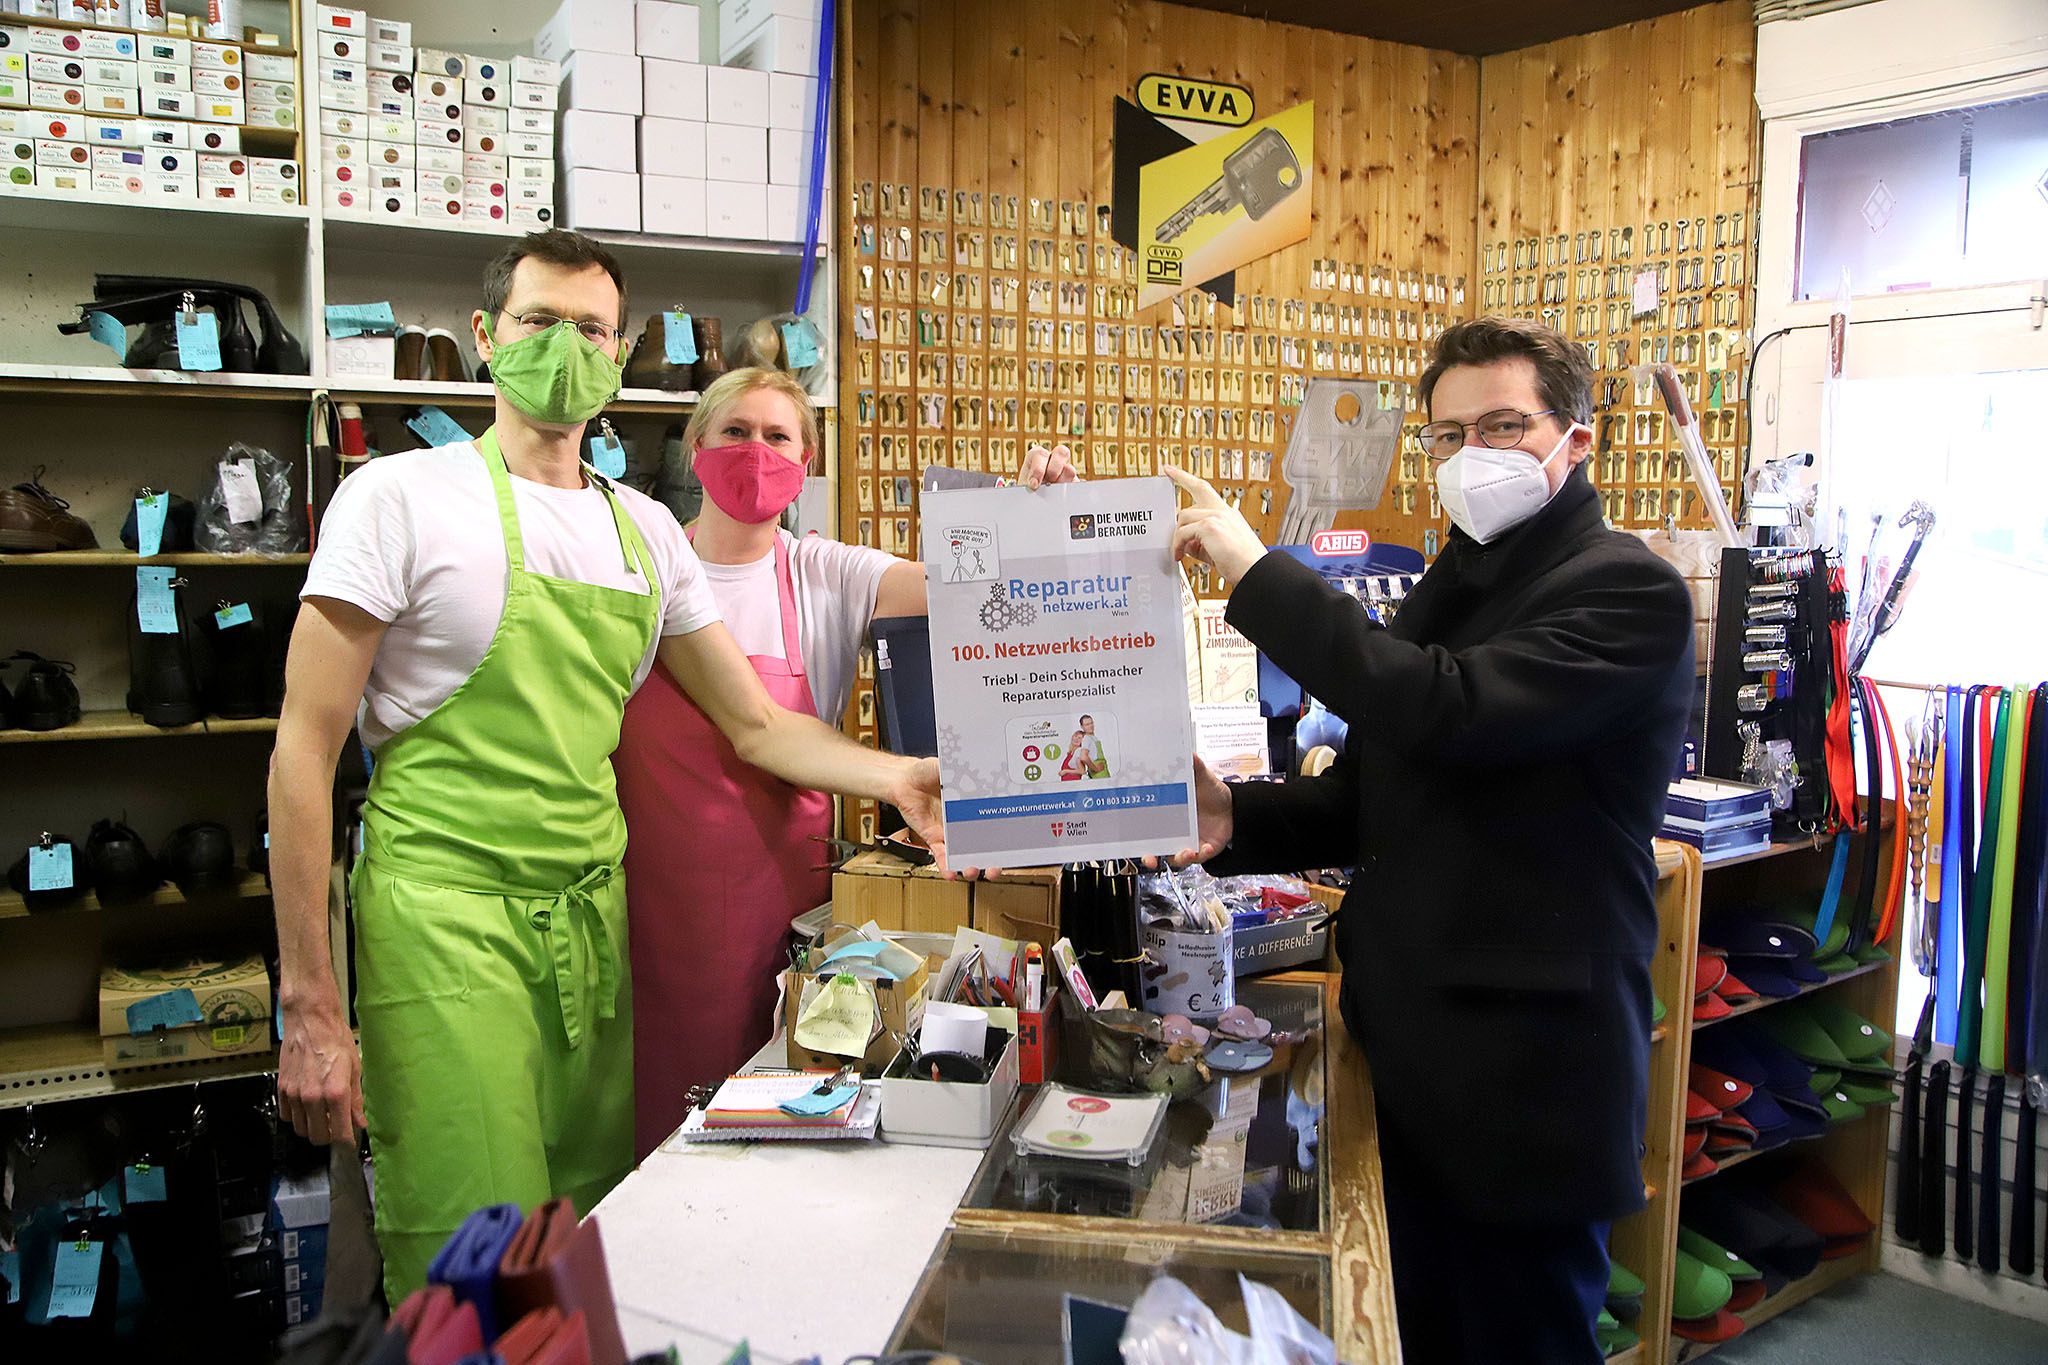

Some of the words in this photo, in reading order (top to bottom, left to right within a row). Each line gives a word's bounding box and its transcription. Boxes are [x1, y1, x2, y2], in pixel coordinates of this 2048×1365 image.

[1157, 83, 1239, 117] EVVA
[1153, 248, 1178, 258] EVVA
[1147, 259, 1182, 278] DPI
[1097, 513, 1111, 524] DIE
[1114, 510, 1153, 523] UMWELT
[1098, 525, 1147, 538] BERATUNG
[1319, 535, 1362, 551] ABUS
[1009, 574, 1132, 602] Reparatur
[1043, 594, 1128, 613] netzwerk.at
[1203, 616, 1237, 636] TER
[951, 644, 990, 662] 100.
[994, 632, 1156, 659] Netzwerksbetrieb
[983, 673, 1018, 687] Triebl
[1029, 670, 1057, 684] Dein
[1060, 665, 1144, 681] Schuhmacher
[1002, 684, 1116, 704] Reparaturspezialist
[978, 801, 1076, 815] www.reparaturnetzwerk.at
[1096, 798, 1105, 806] 01
[1106, 797, 1120, 806] 803
[1145, 794, 1155, 803] 22
[1066, 821, 1087, 829] Stadt
[1145, 932, 1166, 948] Slip
[1234, 946, 1246, 960] KE
[1248, 945, 1255, 957] A
[1258, 934, 1314, 956] DIFFERENCE!
